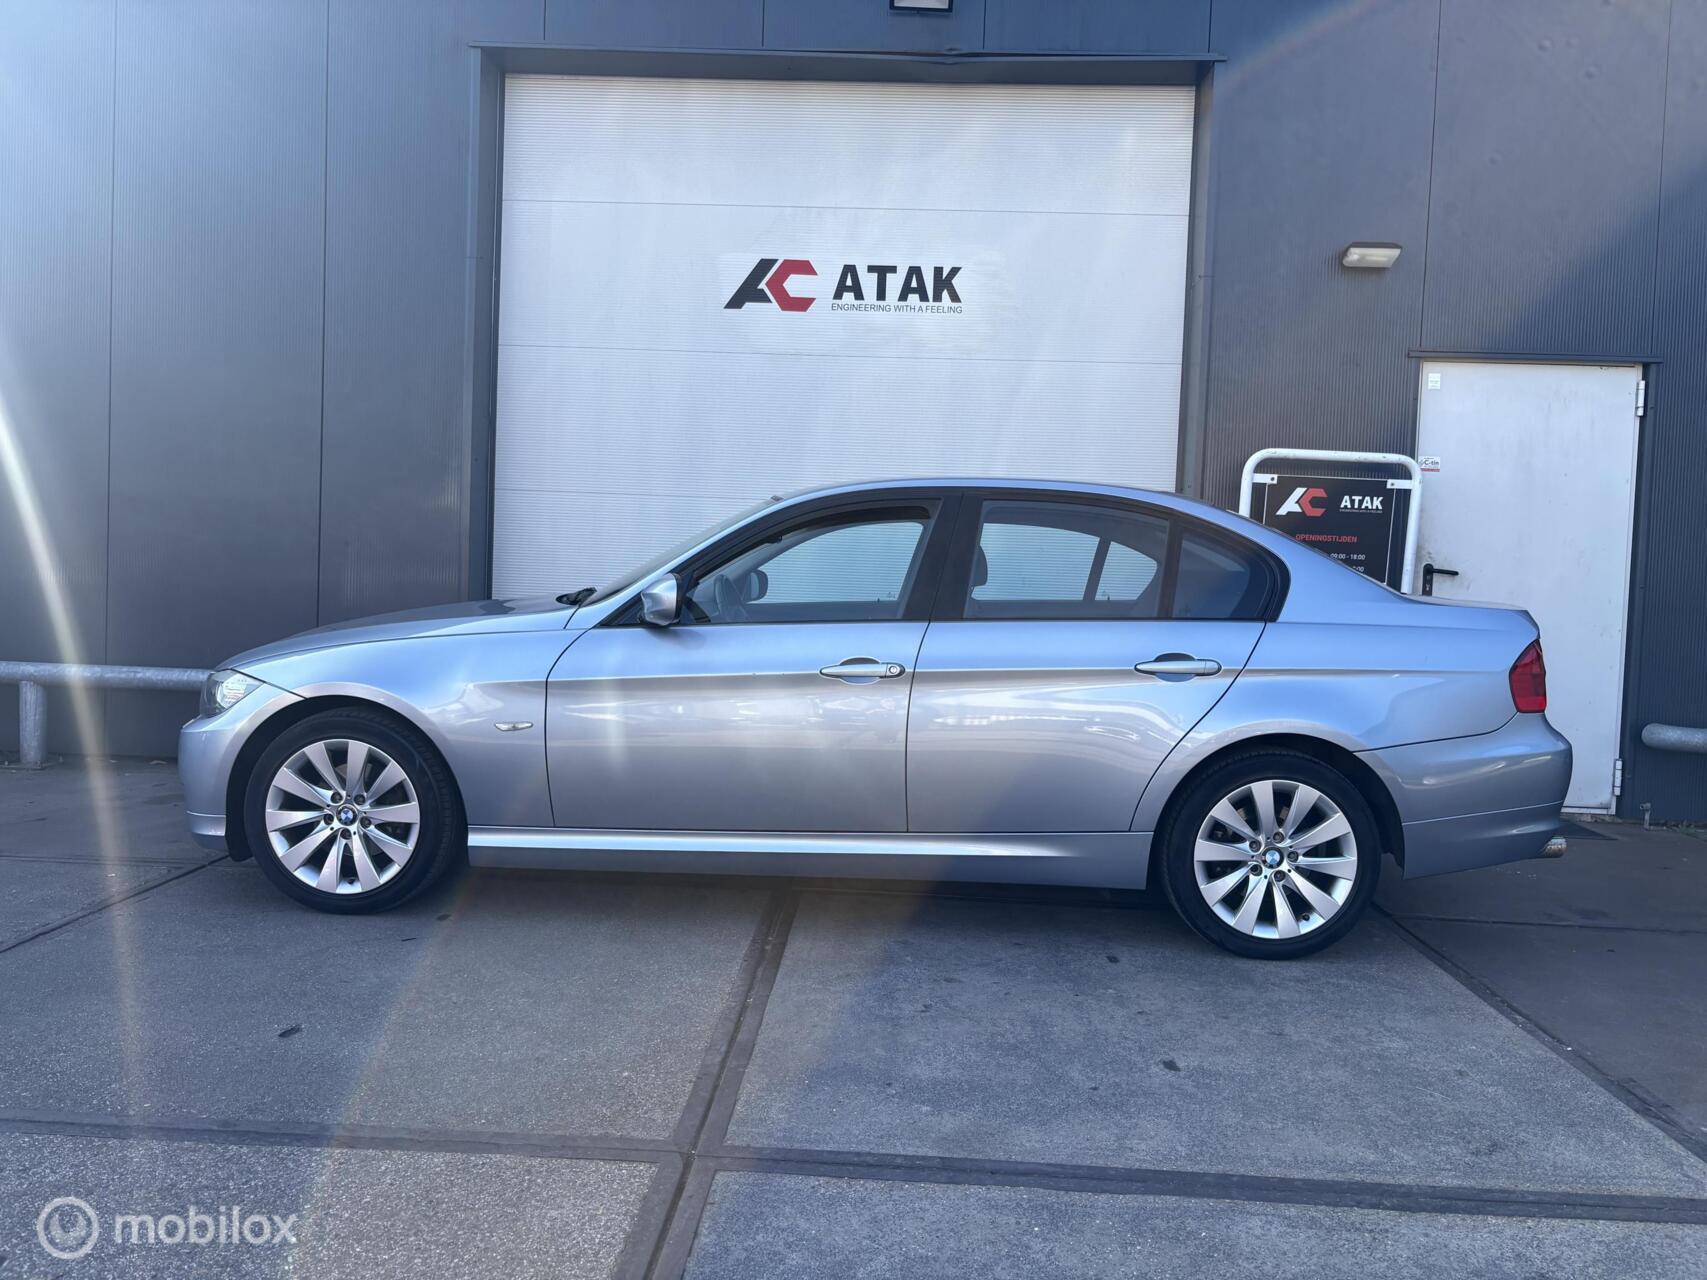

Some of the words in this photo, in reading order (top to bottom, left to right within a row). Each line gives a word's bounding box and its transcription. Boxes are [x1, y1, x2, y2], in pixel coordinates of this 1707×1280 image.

[832, 264, 963, 303] ATAK
[831, 302, 892, 313] ENGINEERING
[893, 304, 916, 313] WITH
[917, 305, 924, 313] A
[925, 305, 963, 314] FEELING
[1340, 495, 1384, 510] ATAK
[1295, 534, 1358, 543] OPENINGSTIJDEN
